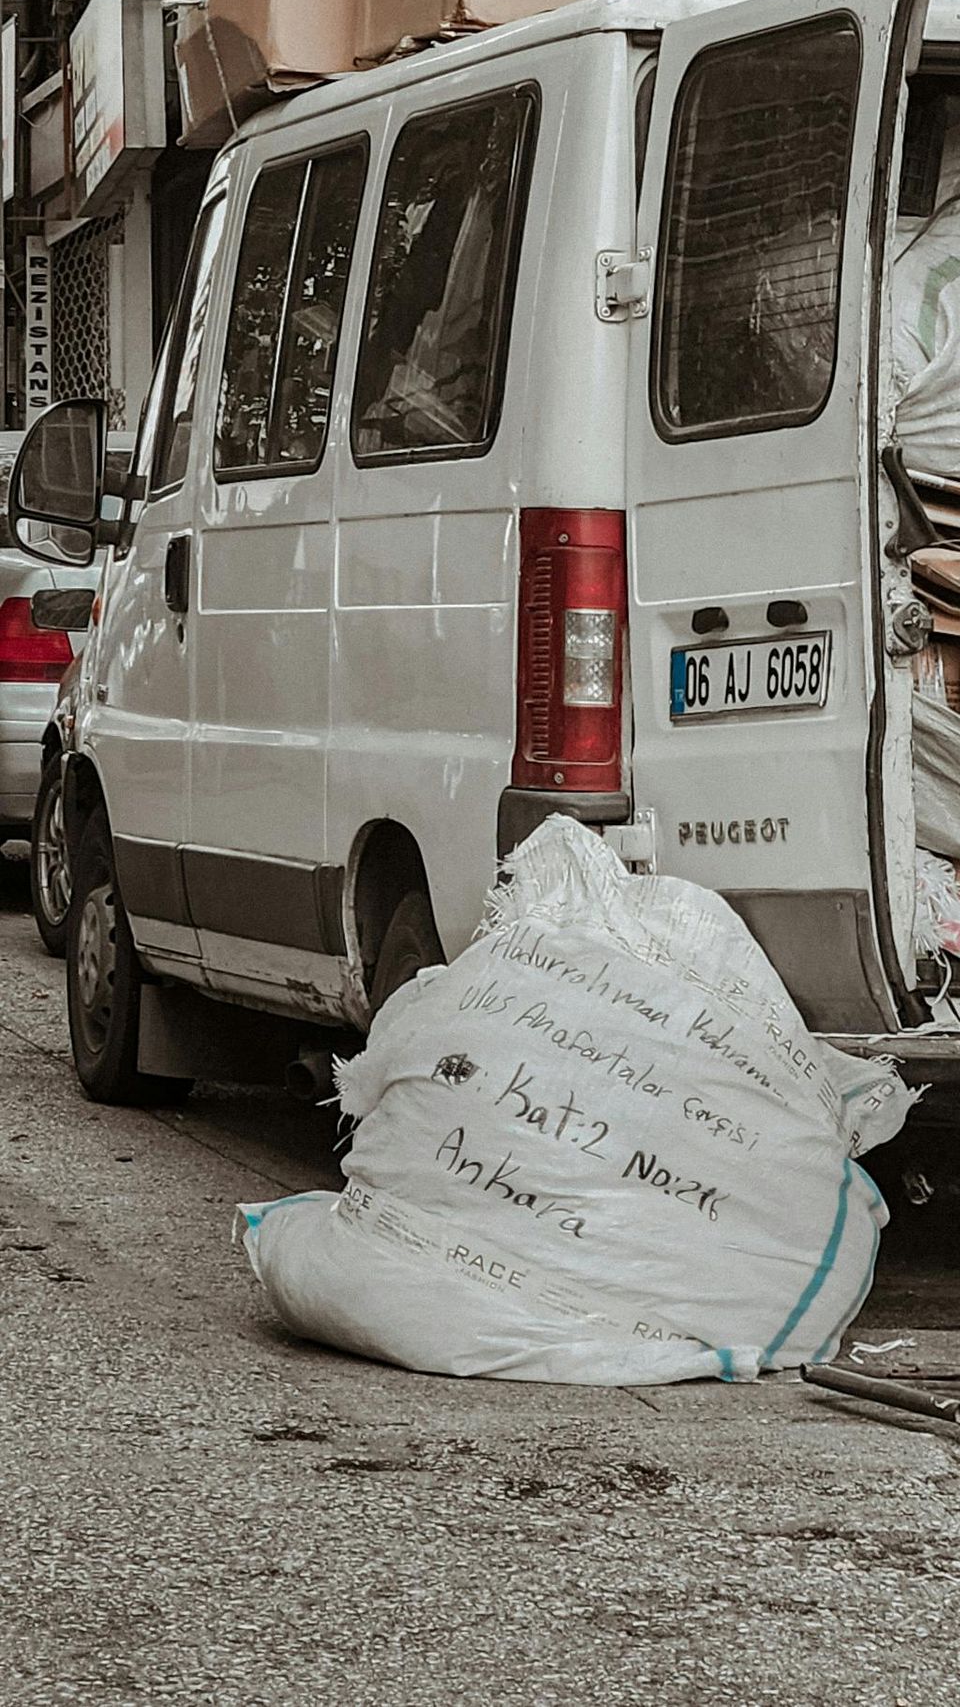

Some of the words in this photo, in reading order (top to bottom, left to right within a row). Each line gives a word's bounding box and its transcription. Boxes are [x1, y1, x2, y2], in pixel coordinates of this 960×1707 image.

[29, 256, 48, 408] REZISTANS
[685, 655, 710, 708] 06
[724, 650, 751, 703] AJ
[766, 643, 822, 700] 6058
[678, 817, 790, 847] PEUGEOT
[766, 1022, 818, 1081] RACE
[494, 1061, 610, 1161] Kat:2
[453, 1244, 526, 1289] RACE
